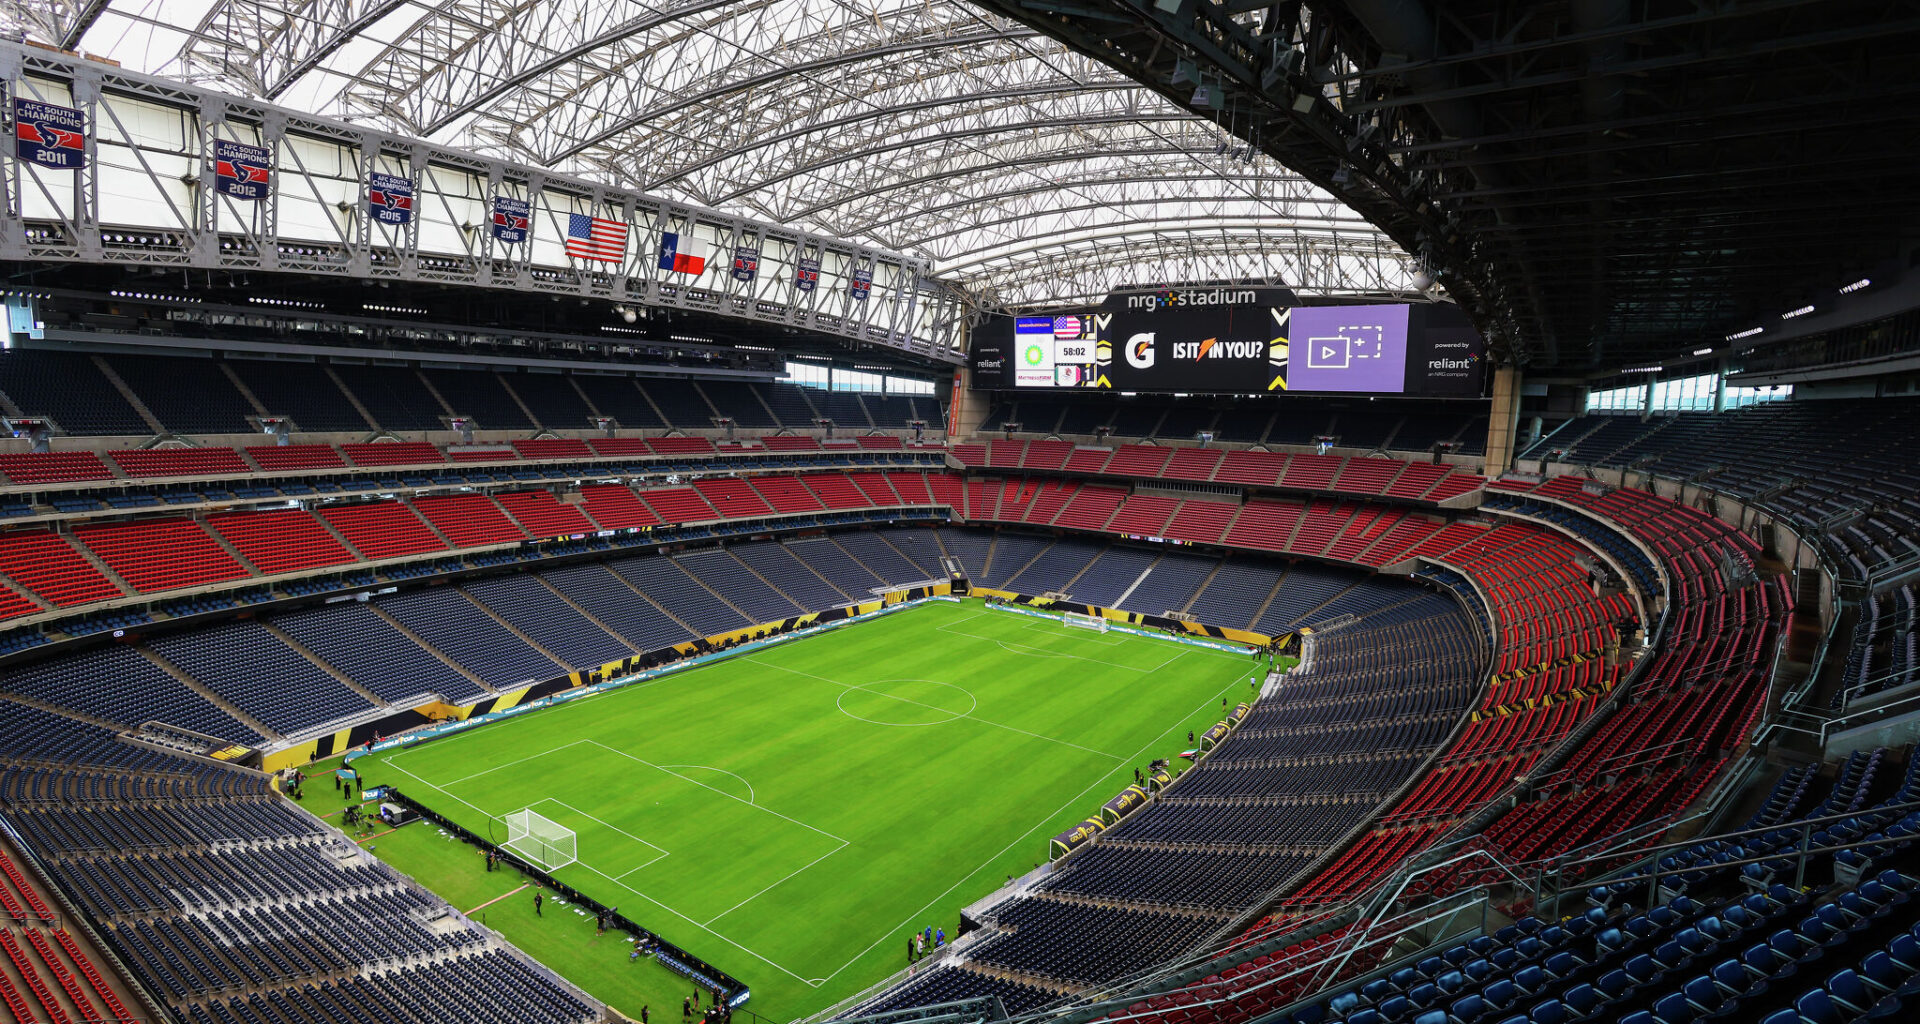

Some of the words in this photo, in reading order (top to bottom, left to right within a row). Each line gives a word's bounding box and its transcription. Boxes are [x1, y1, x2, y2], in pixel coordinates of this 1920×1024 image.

[24, 103, 42, 112] AFC
[44, 106, 75, 118] SOUTH
[17, 108, 81, 128] CHAMPIONS
[217, 148, 268, 164] CHAMPIONS
[224, 143, 238, 151] AFC
[239, 146, 263, 156] SOUTH
[36, 149, 67, 165] 2011
[372, 179, 412, 193] CHAMPIONS
[377, 175, 389, 183] AFC
[390, 178, 408, 186] SOUTH
[229, 183, 257, 197] 2012
[496, 203, 529, 214] CHAMPIONS
[379, 210, 401, 222] 2015
[500, 230, 519, 240] 2016
[1128, 294, 1157, 312] nrg
[1177, 288, 1256, 306] stadium
[1084, 320, 1091, 333] 1
[1063, 347, 1086, 356] 58:02
[1125, 332, 1156, 369] G
[1172, 342, 1186, 359] IS
[1186, 342, 1200, 359] IT
[1208, 341, 1224, 359] IN
[1224, 341, 1264, 359] YOU?
[977, 359, 1001, 368] reliant
[1428, 358, 1470, 369] reliant
[1084, 368, 1091, 381] 1
[518, 704, 531, 712] GOLD
[454, 720, 470, 729] GOLD
[383, 740, 399, 748] GOLD
[403, 735, 415, 743] CUP
[1070, 832, 1083, 843] GOLD
[1085, 825, 1096, 834] CUP
